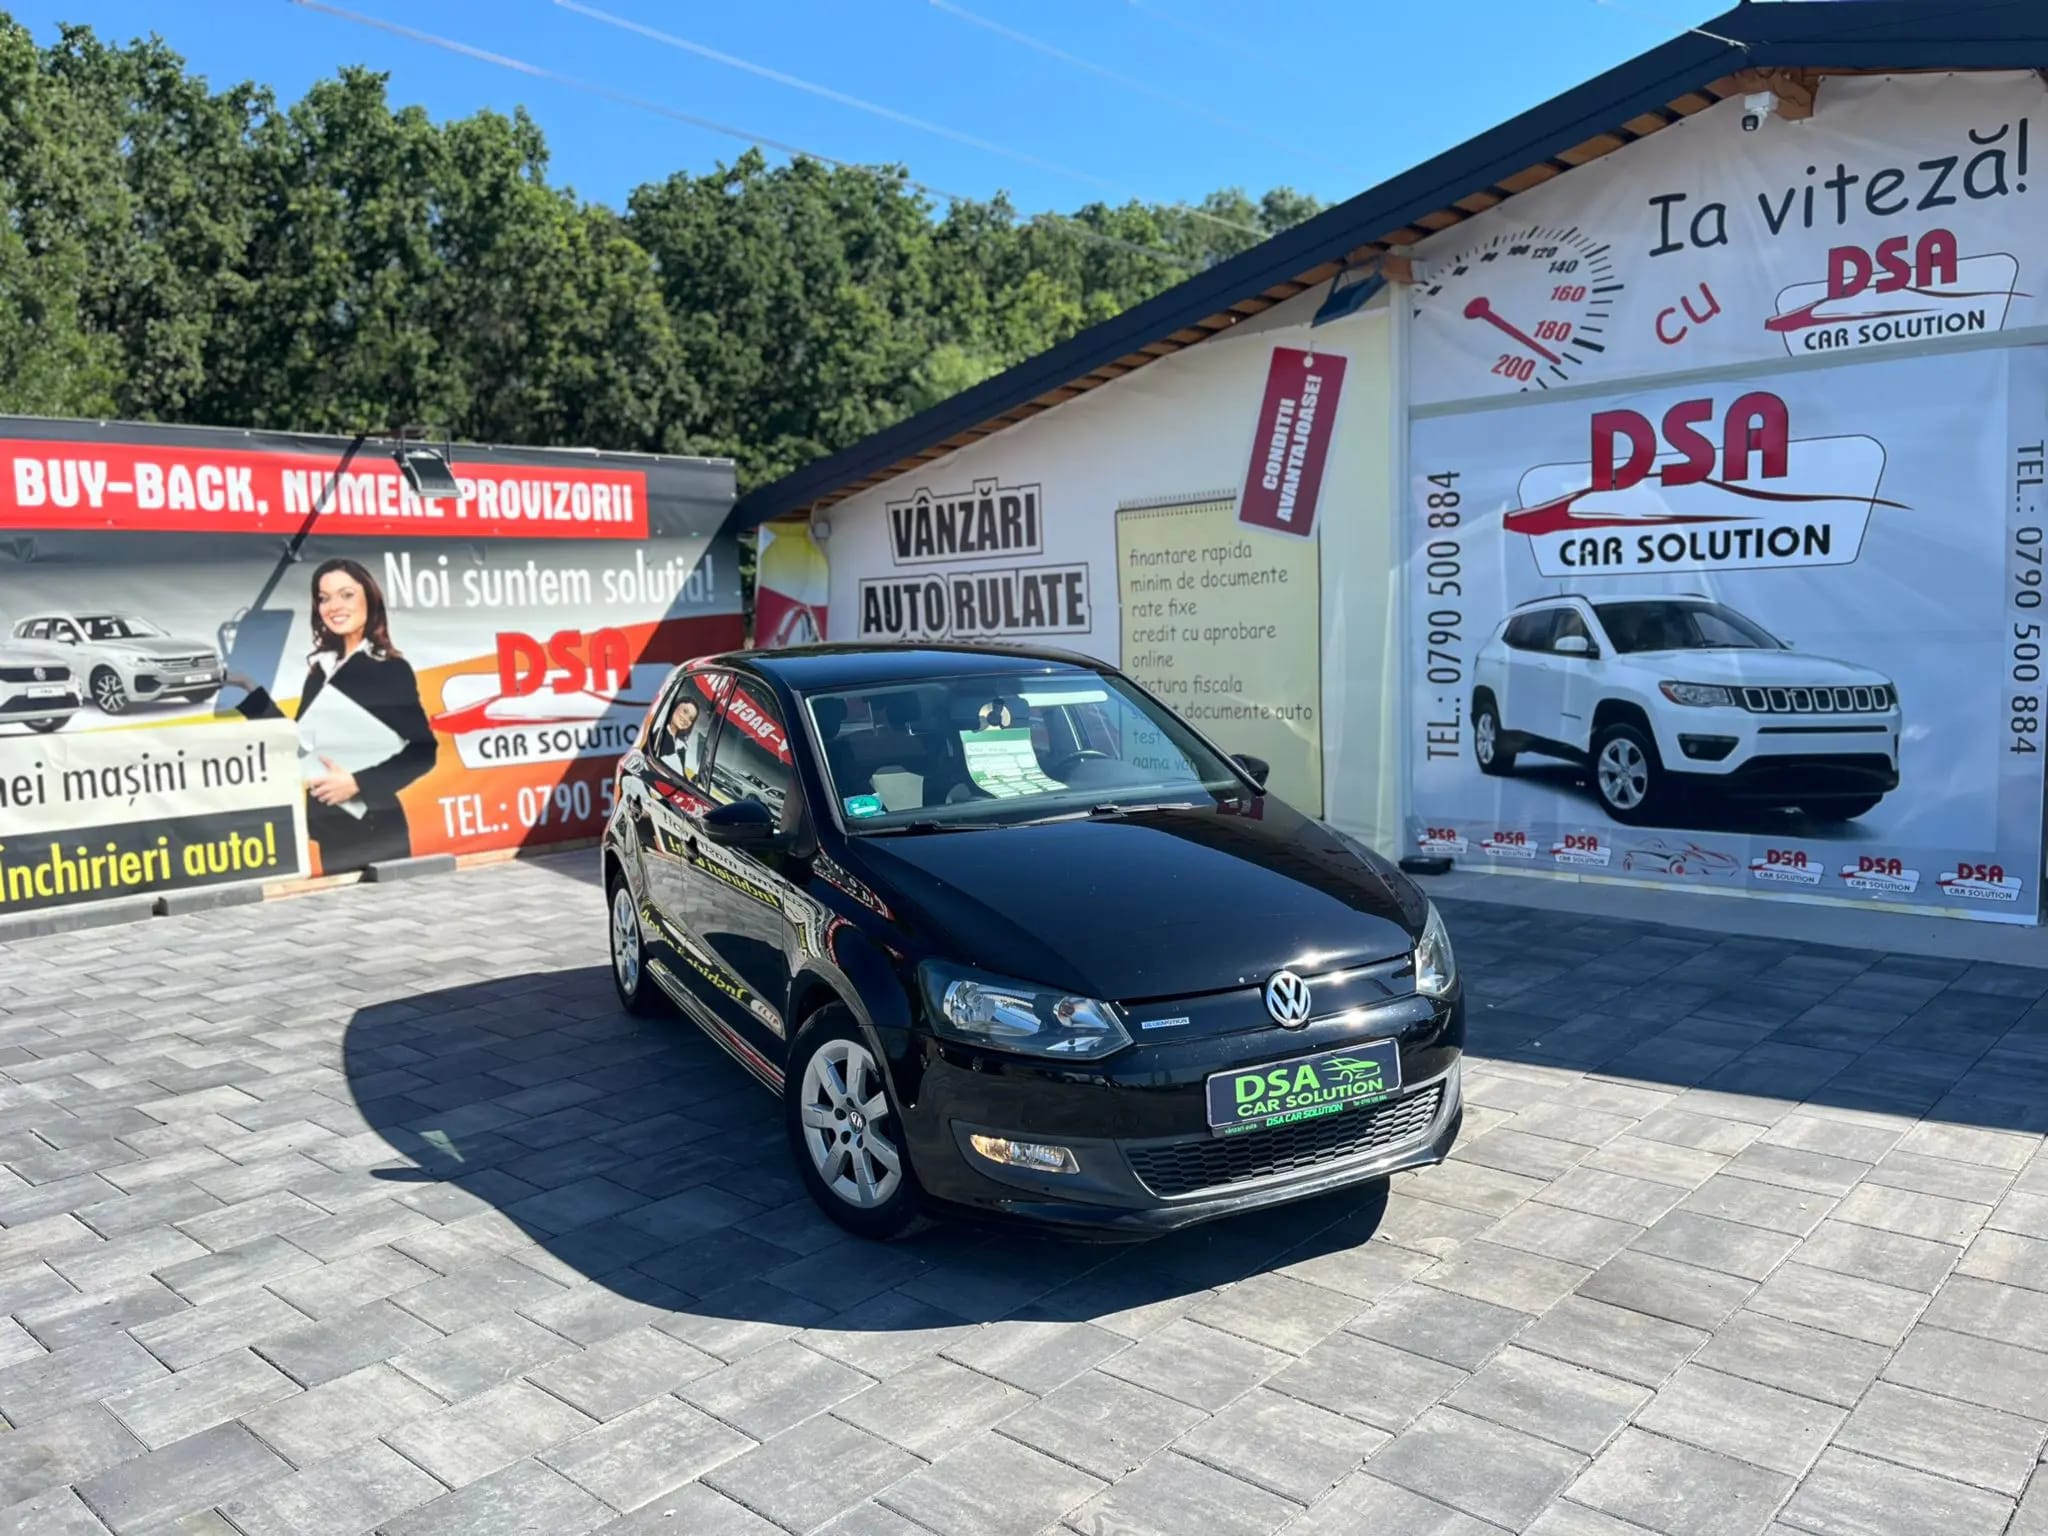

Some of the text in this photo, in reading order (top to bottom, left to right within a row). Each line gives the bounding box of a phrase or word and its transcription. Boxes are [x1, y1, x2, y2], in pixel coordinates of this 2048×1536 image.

[1648, 118, 2029, 257] Ia viteză!
[1548, 259, 1579, 274] 140
[1828, 228, 1957, 299] DSA
[1551, 285, 1586, 302] 160
[1655, 282, 1721, 344] cu
[1533, 320, 1572, 342] 180
[1804, 310, 1985, 351] CAR SOLUTION
[1491, 353, 1536, 381] 200
[1276, 374, 1322, 522] AVANTAJOASE!
[1591, 391, 1789, 493] DSA
[13, 458, 269, 517] BUY-BACK,
[455, 477, 634, 521] PROVIZORII
[892, 486, 1036, 558] VÂNZĂRI
[1129, 540, 1252, 568] finantare rapida
[1559, 524, 1831, 567] CAR SOLUTION
[384, 552, 449, 608] Noi
[463, 560, 592, 607] suntem
[1130, 566, 1288, 592] minim de documente
[863, 572, 1086, 634] AUTO RULATE
[1132, 598, 1197, 617] rate fixe
[2010, 439, 2044, 755] TEL.: 0790 500 884
[1427, 471, 1462, 761] TEL.: 0790 500 884
[1132, 621, 1277, 646] credit cu aprobare
[496, 627, 632, 698] DSA
[1132, 650, 1174, 668] online
[1193, 674, 1242, 695] fiscala
[1185, 701, 1270, 720] documente
[1276, 703, 1313, 720] auto
[479, 734, 528, 759] CAR
[63, 749, 187, 807] mașini
[202, 741, 268, 788] noi!
[439, 795, 509, 838] TEL.:
[518, 782, 591, 828] 0790
[1427, 828, 1456, 841] DSA
[1494, 832, 1526, 846] DSA
[1564, 834, 1598, 851] DSA
[183, 822, 278, 878] auto!
[1767, 849, 1807, 868] DSA
[1859, 856, 1902, 875] DSA
[1958, 863, 2004, 883] DSA
[1869, 881, 1911, 891] SOLUTION
[1968, 889, 2012, 899] SOLUTION
[1235, 1064, 1320, 1103] DSA
[1237, 1098, 1280, 1117] CAR
[1286, 1078, 1383, 1108] SOLUTION
[1266, 1102, 1343, 1127] DSA CAR SOLUTION
